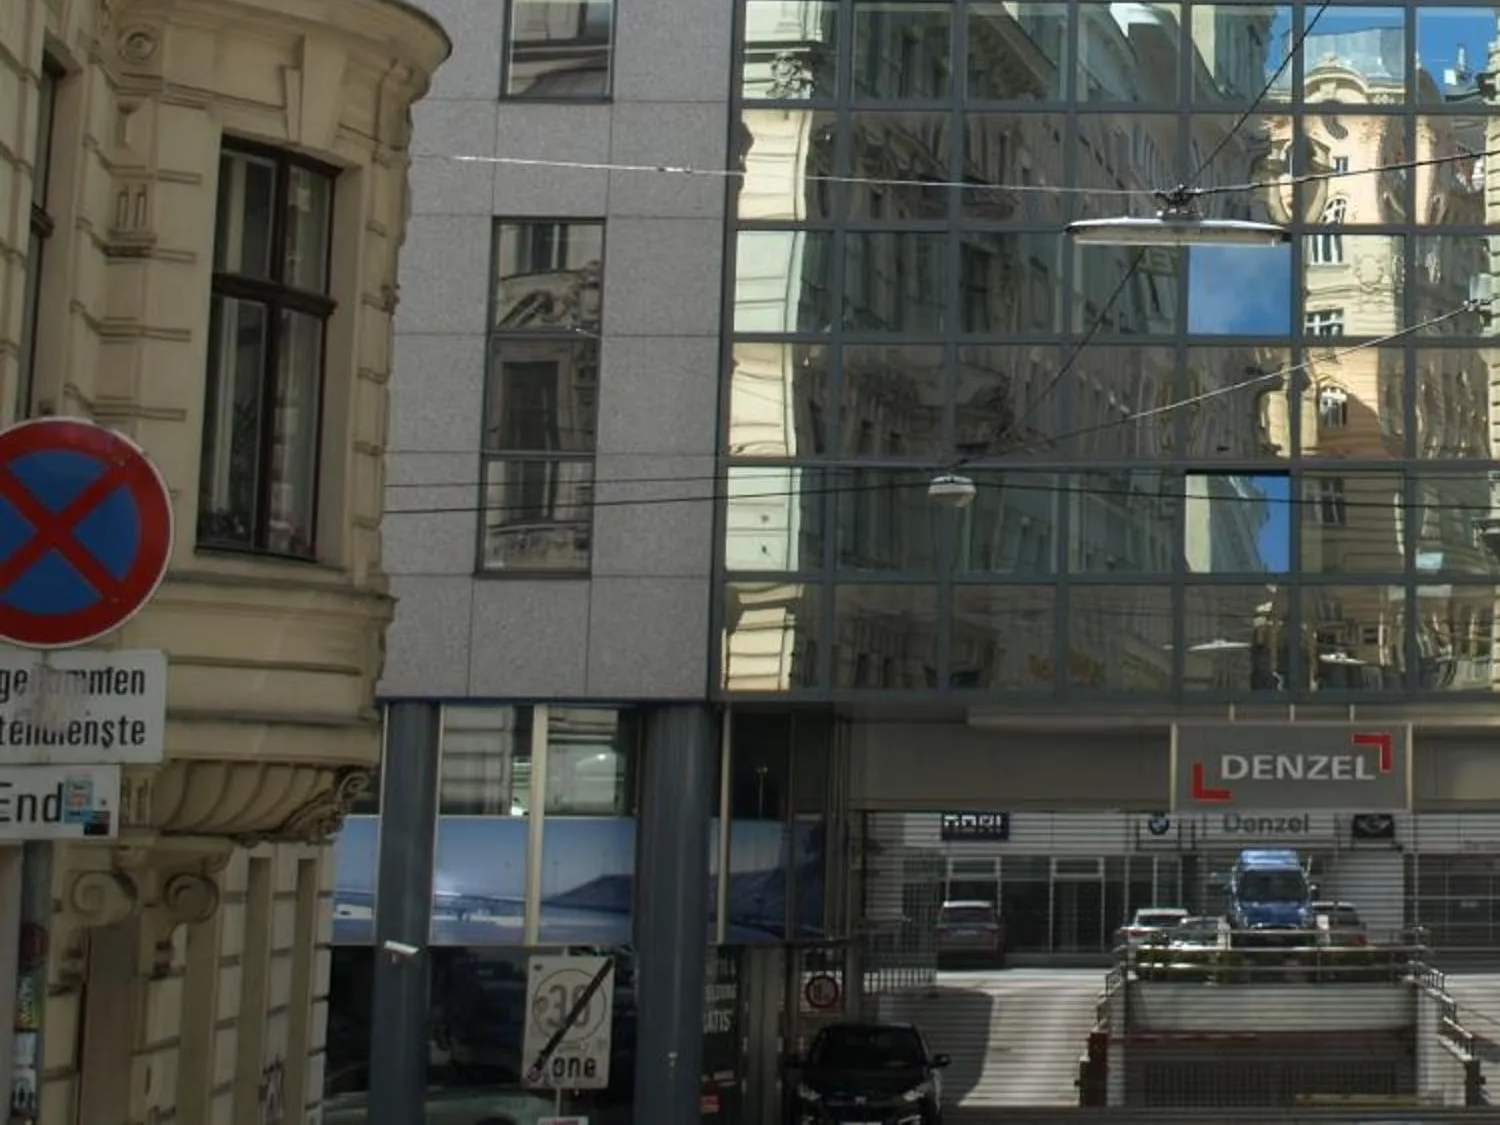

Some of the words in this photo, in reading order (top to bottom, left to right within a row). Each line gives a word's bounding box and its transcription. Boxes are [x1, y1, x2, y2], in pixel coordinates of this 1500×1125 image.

[1221, 754, 1377, 781] DENZEL
[1224, 812, 1309, 833] Denzel
[548, 983, 592, 1028] 30
[548, 1057, 597, 1079] one
